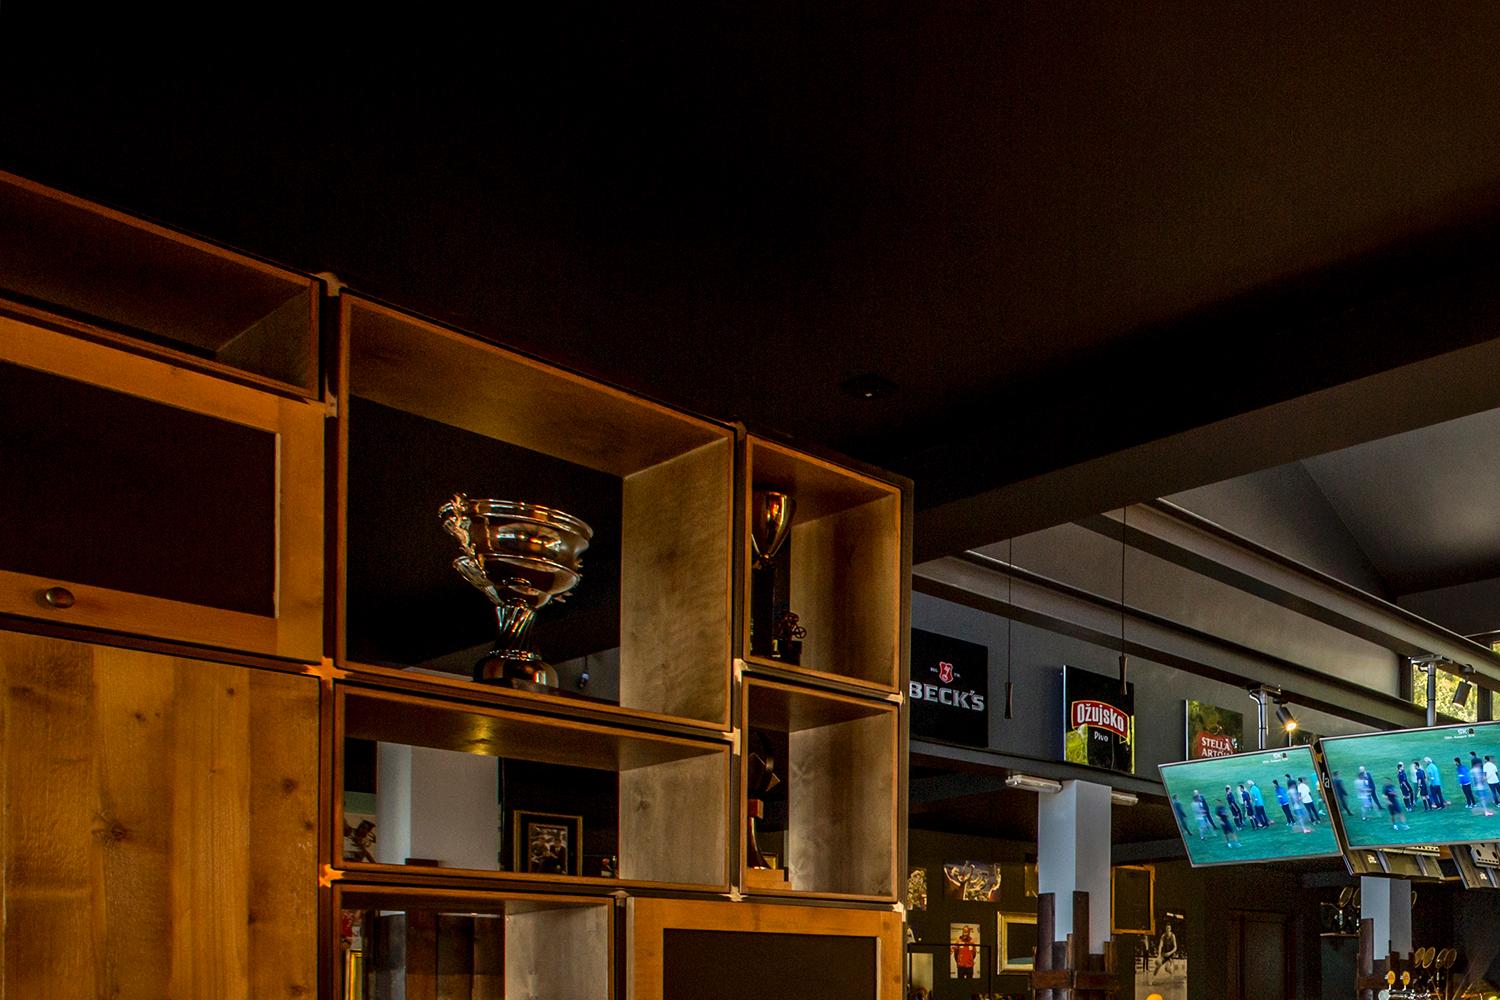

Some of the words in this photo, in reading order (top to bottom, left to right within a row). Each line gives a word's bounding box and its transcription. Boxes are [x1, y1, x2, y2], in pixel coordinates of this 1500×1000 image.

[909, 680, 985, 712] BECK'S
[1077, 704, 1125, 732] Ožujsko
[1201, 736, 1231, 751] STELLA
